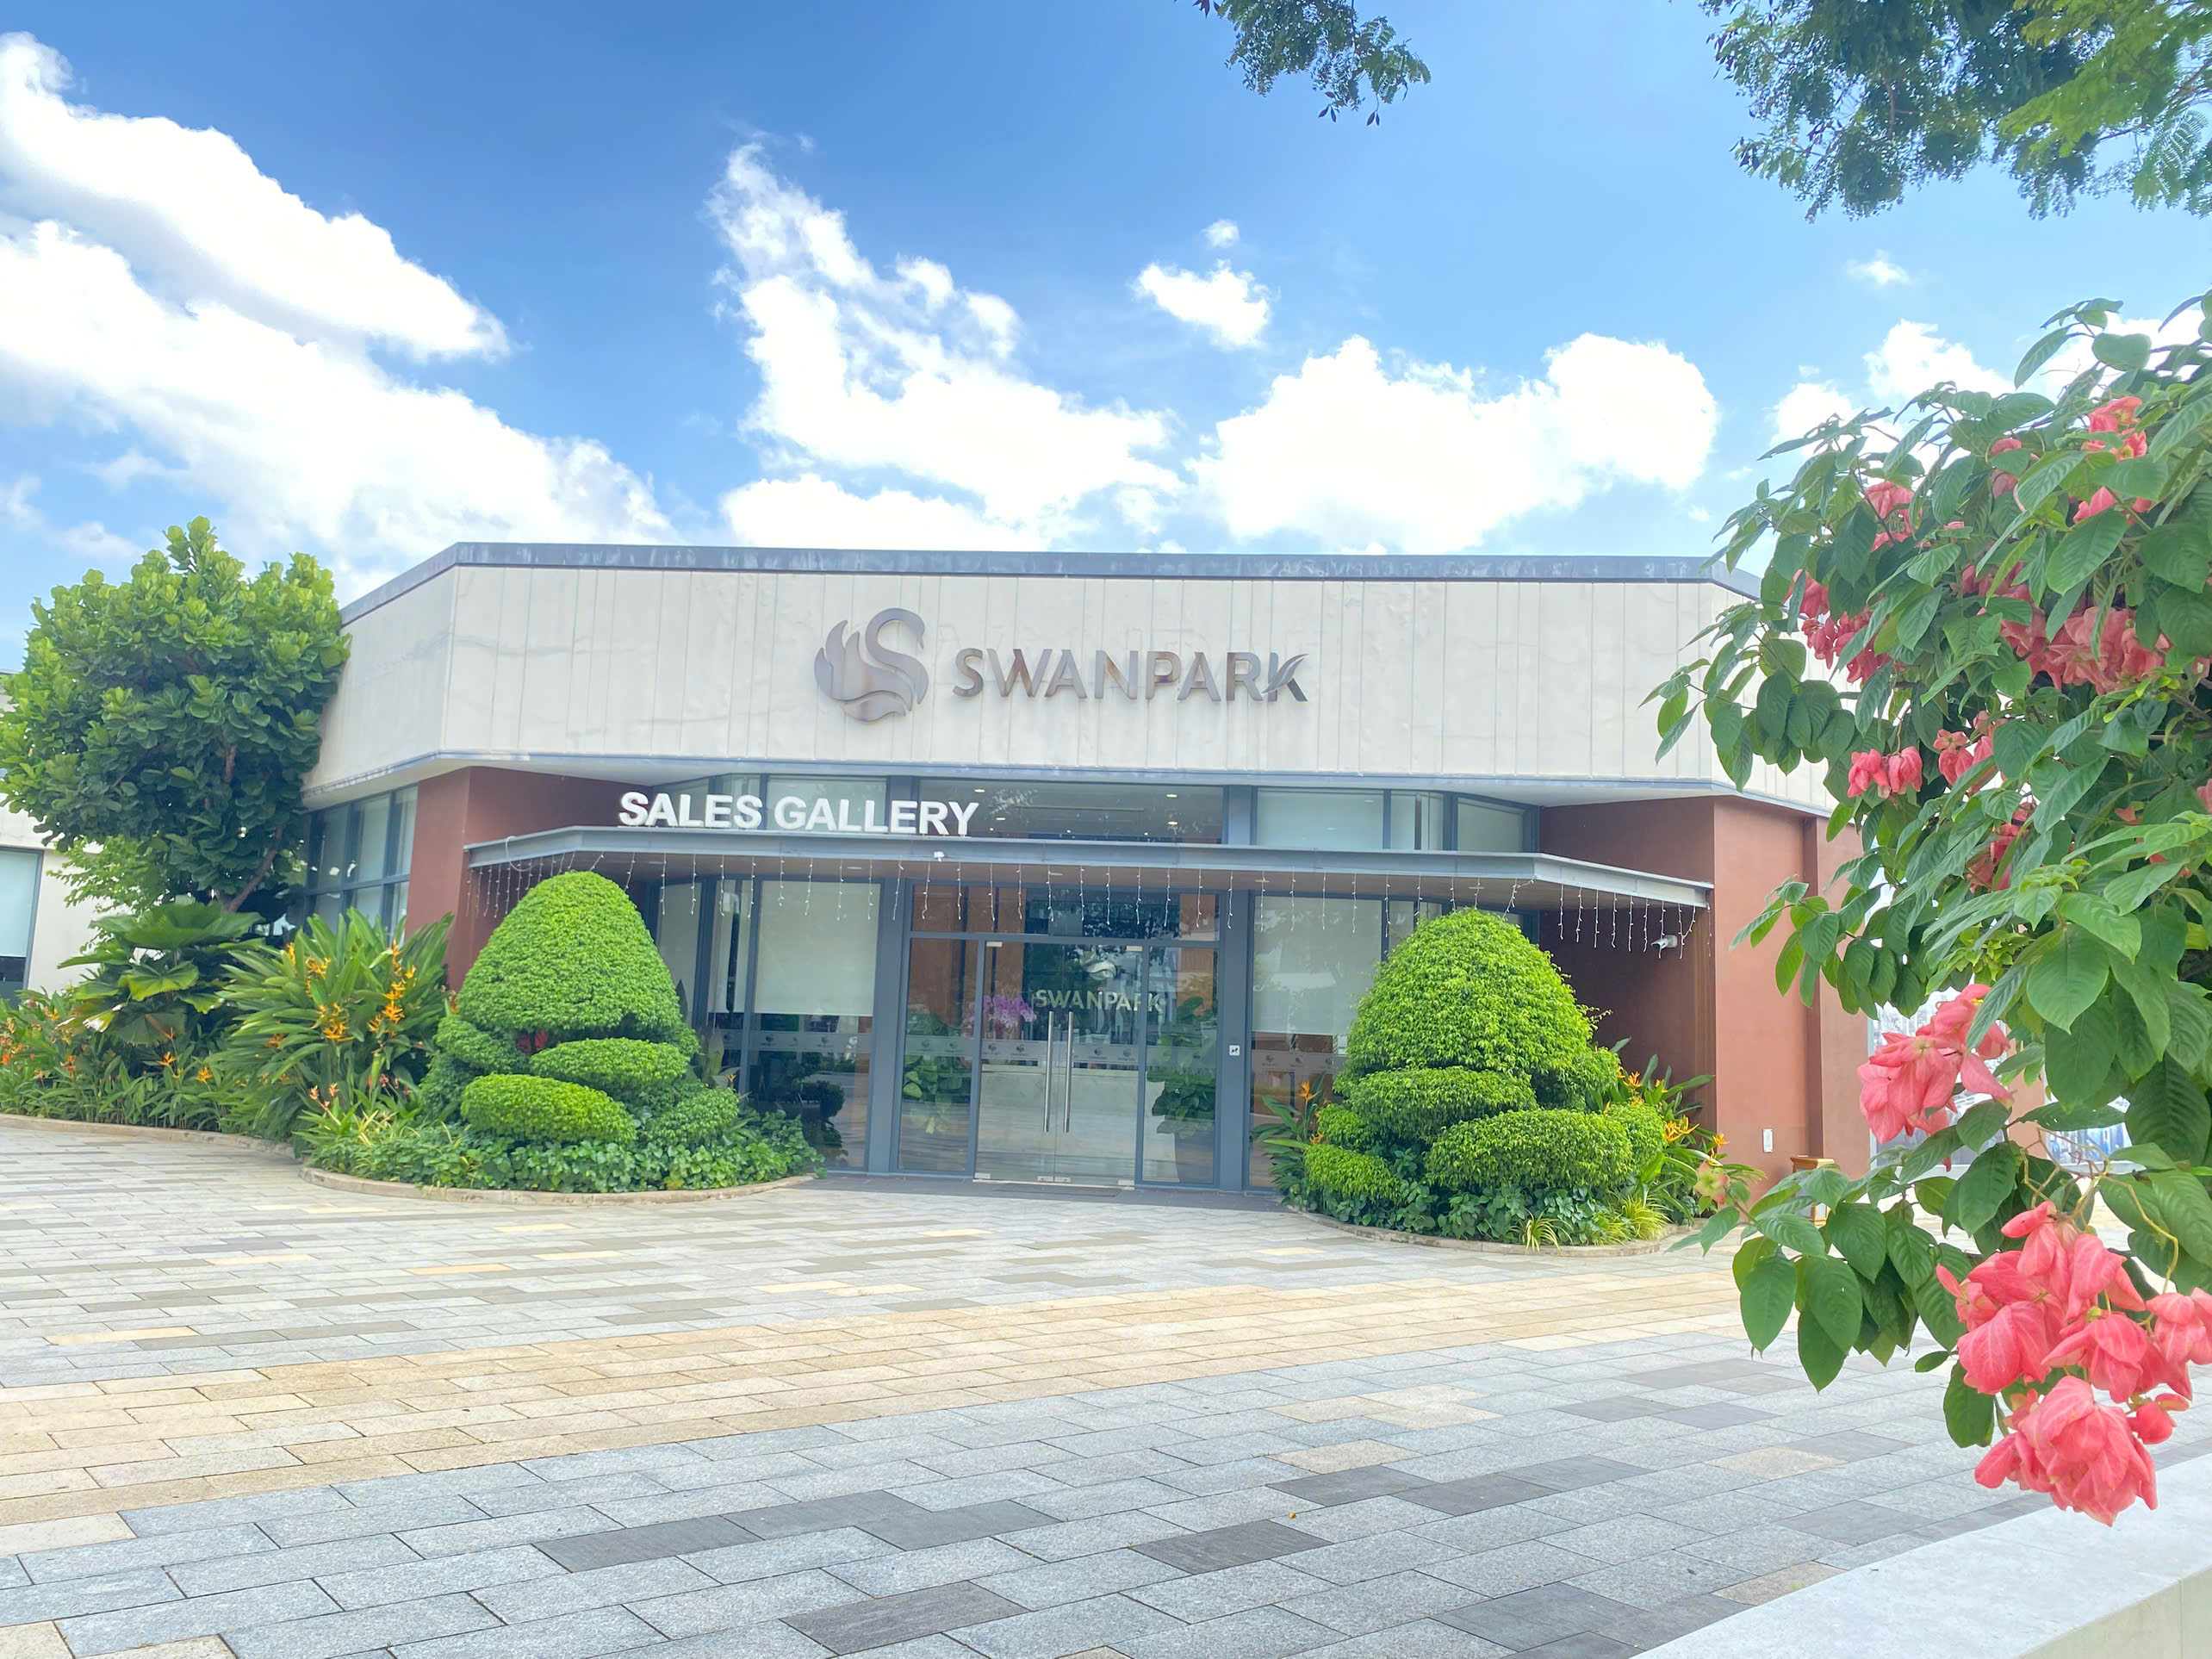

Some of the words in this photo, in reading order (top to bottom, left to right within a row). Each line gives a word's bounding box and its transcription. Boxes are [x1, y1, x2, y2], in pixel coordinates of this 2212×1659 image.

[953, 648, 1308, 702] SWANPARK
[618, 792, 762, 829] SALES
[774, 796, 979, 836] GALLERY
